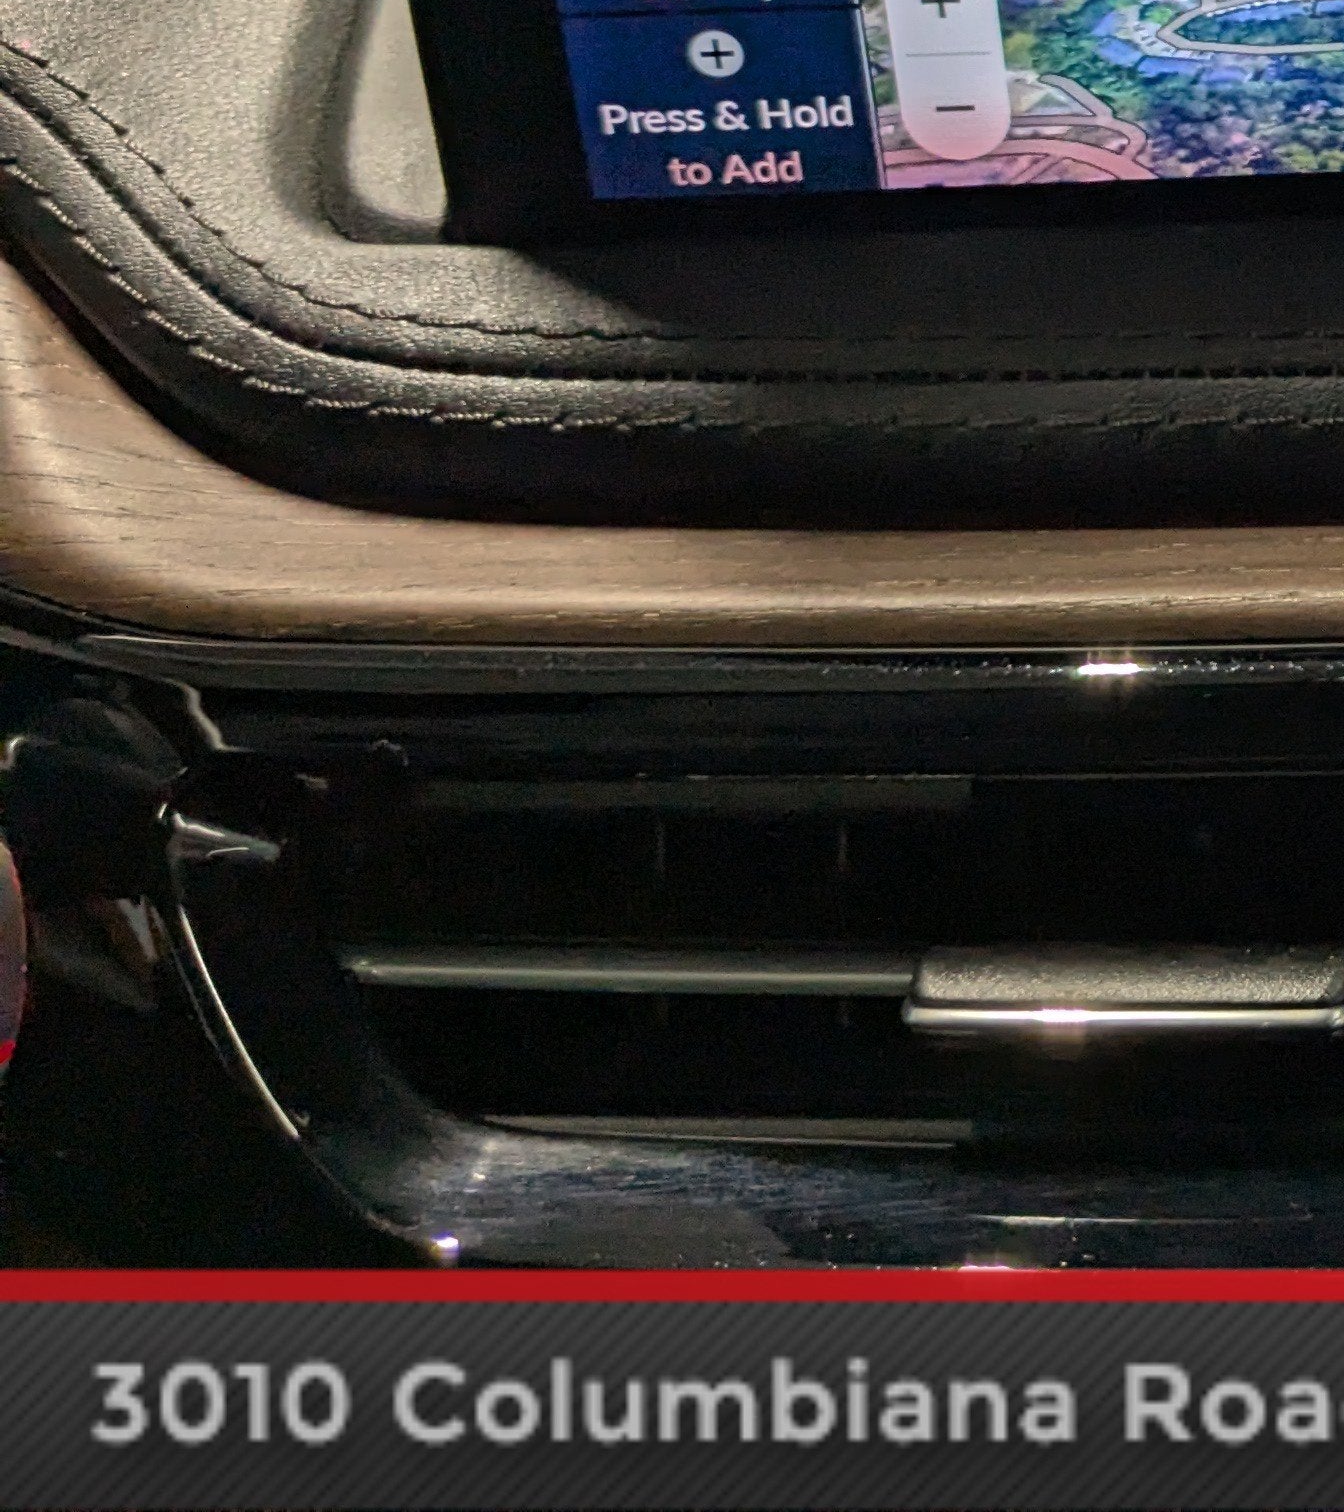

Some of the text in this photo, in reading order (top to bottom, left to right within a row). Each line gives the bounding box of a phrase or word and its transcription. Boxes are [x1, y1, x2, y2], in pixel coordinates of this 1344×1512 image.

[599, 95, 854, 136] Press & Hold
[668, 150, 804, 187] to Add
